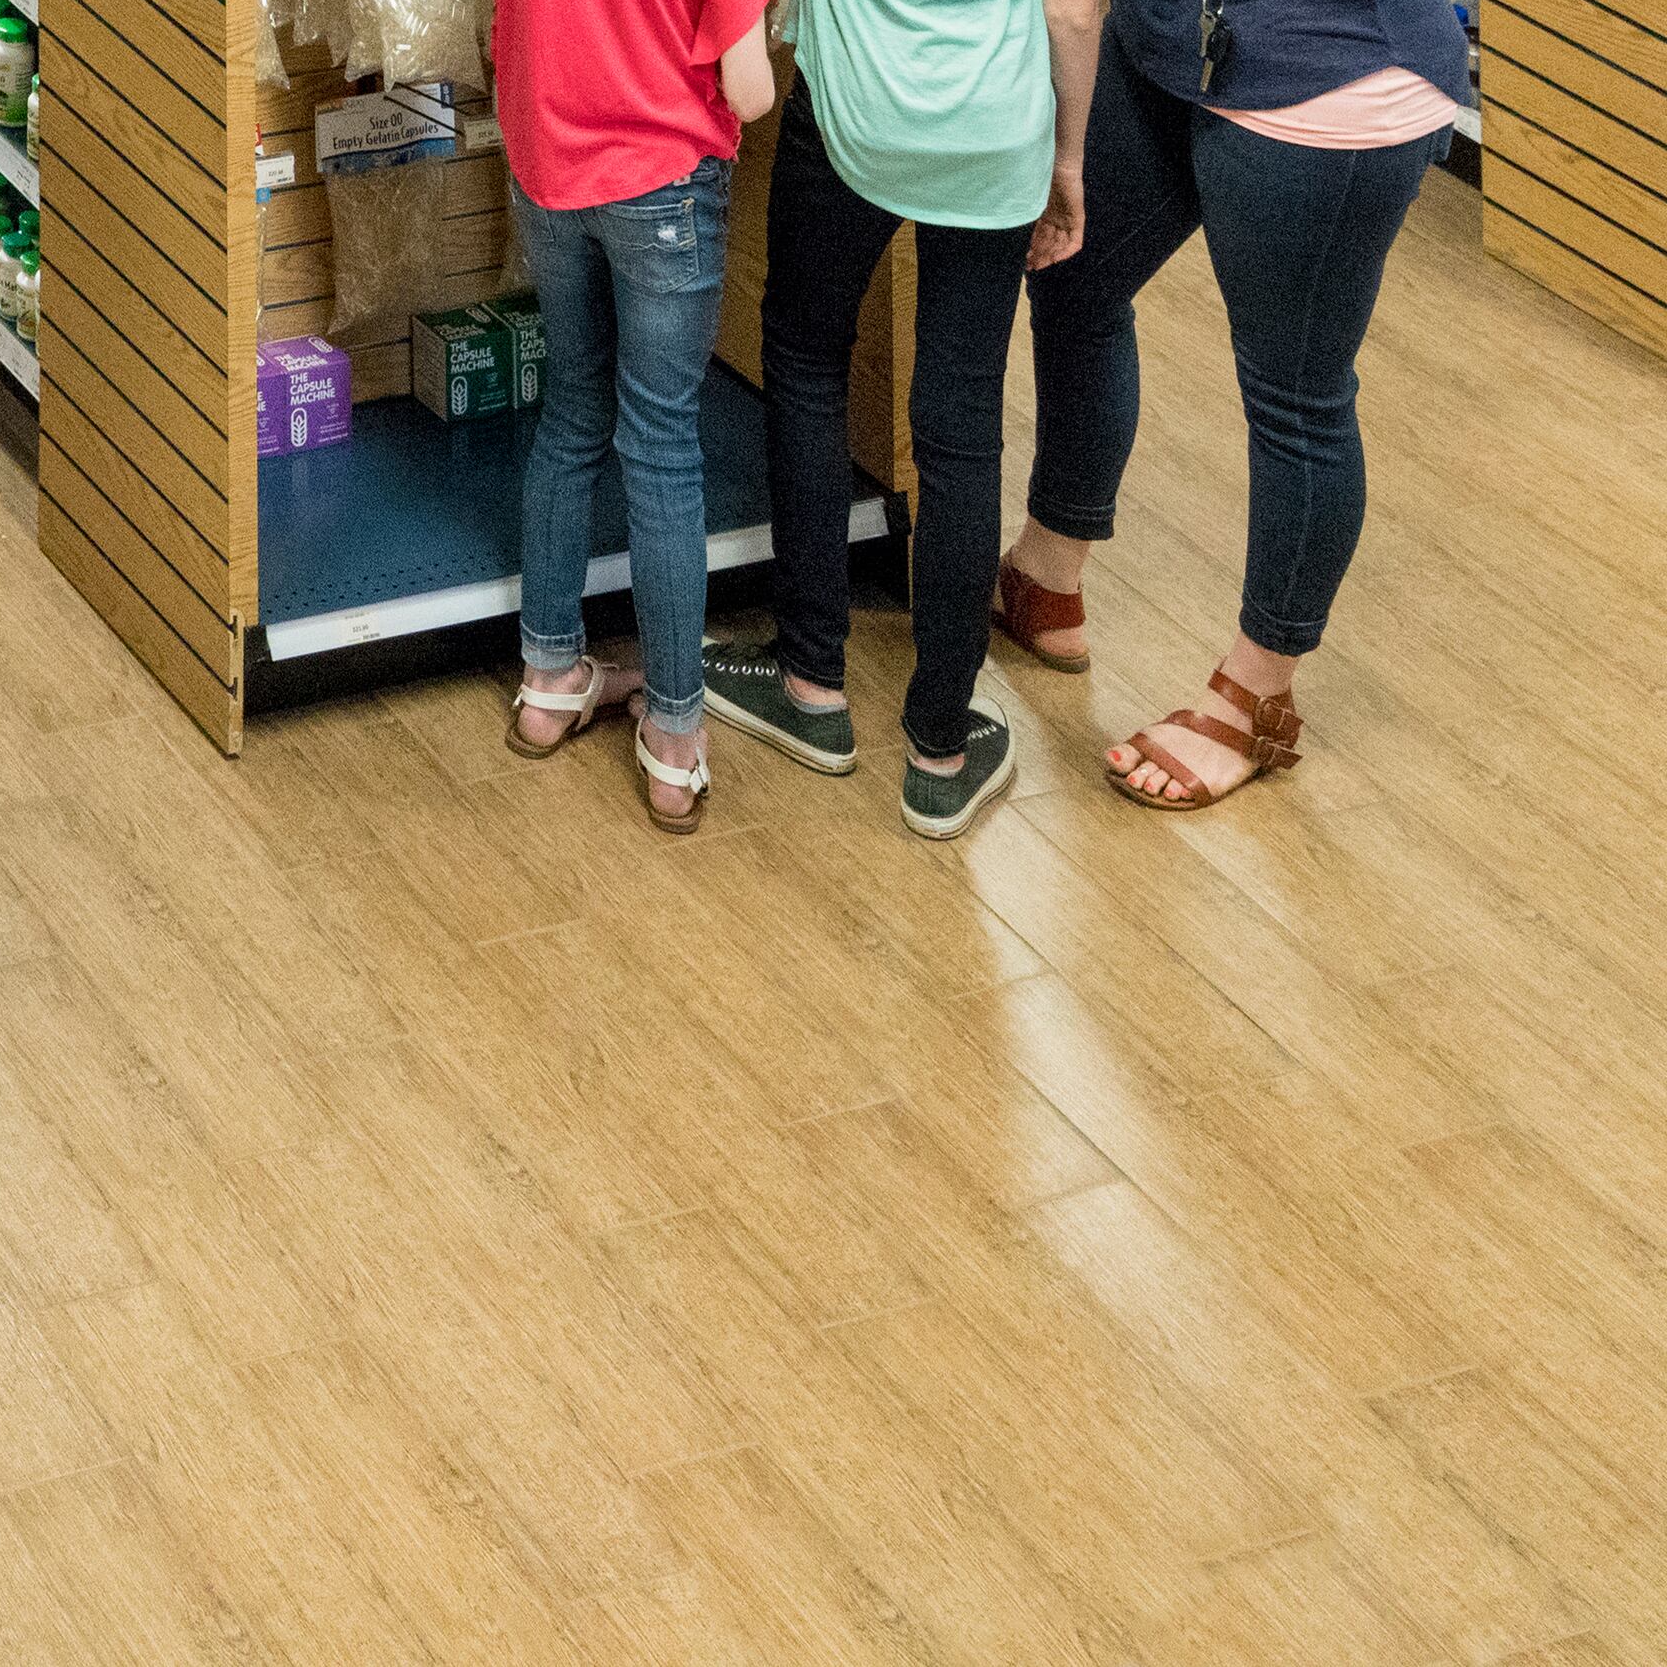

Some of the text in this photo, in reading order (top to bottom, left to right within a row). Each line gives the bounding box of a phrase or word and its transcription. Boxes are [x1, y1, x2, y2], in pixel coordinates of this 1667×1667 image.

[370, 113, 403, 130] Size 00
[333, 123, 439, 150] Empty Gelatin Capsules
[521, 332, 537, 341] THE
[450, 342, 467, 352] THE
[450, 347, 493, 364] CAPSULE
[450, 357, 495, 374] MACHINE
[290, 375, 308, 385] THE
[290, 379, 332, 396] CAPSULE
[290, 388, 335, 406] MACHINE
